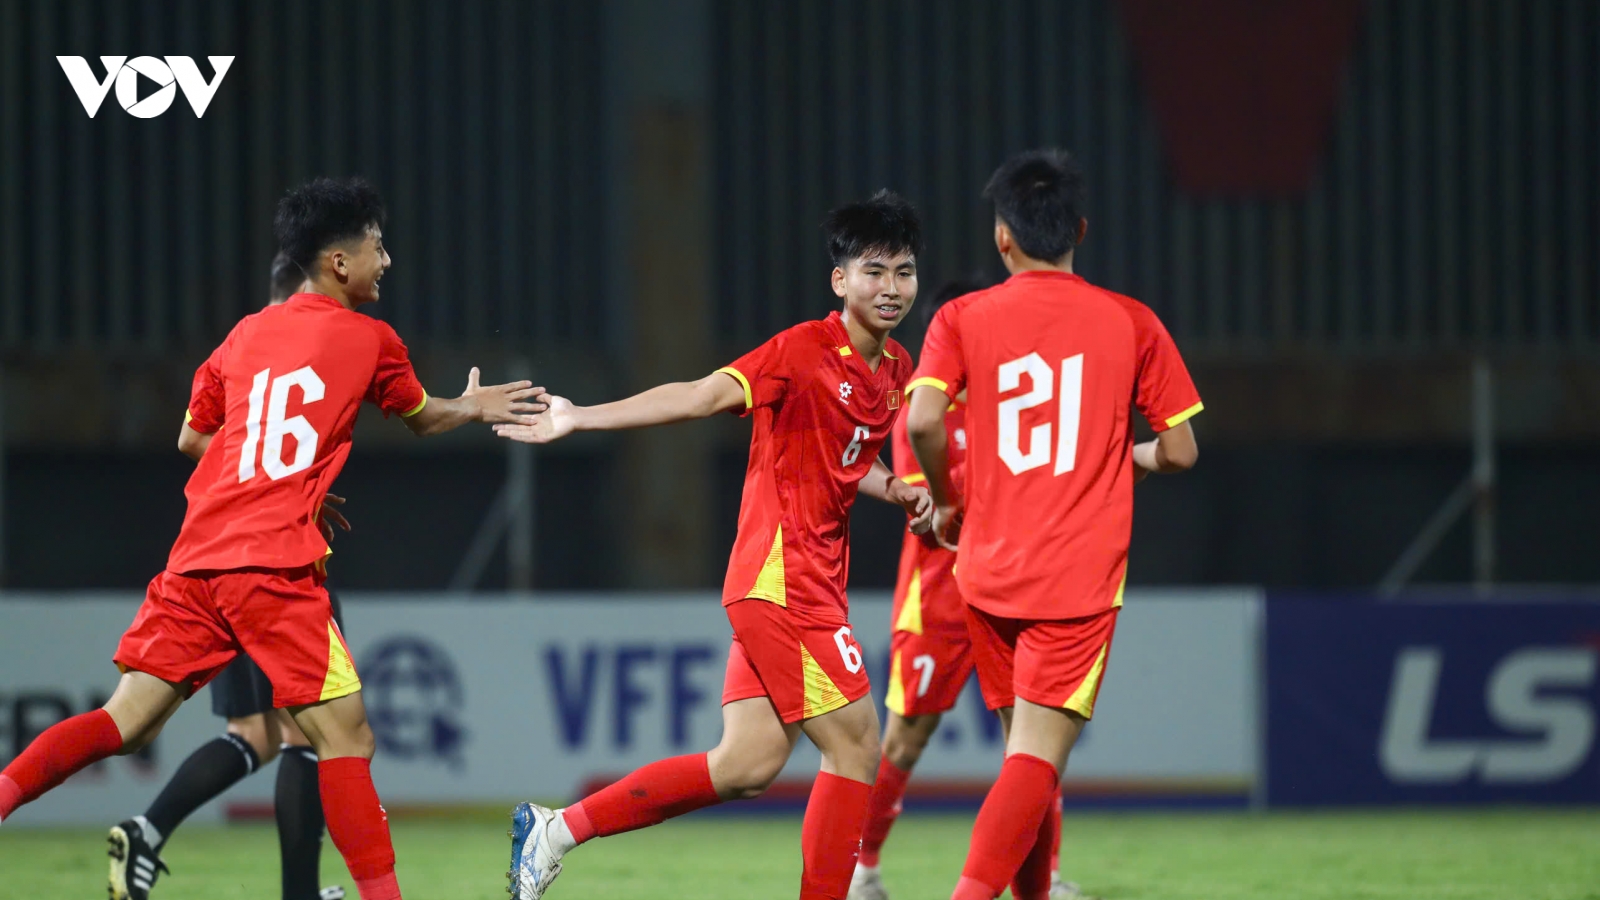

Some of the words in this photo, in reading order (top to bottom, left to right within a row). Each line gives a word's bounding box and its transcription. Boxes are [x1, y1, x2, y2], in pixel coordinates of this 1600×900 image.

[238, 365, 325, 483] 16
[842, 426, 870, 468] 6
[998, 351, 1084, 477] 21
[833, 625, 863, 675] 6
[1380, 646, 1597, 783] LS
